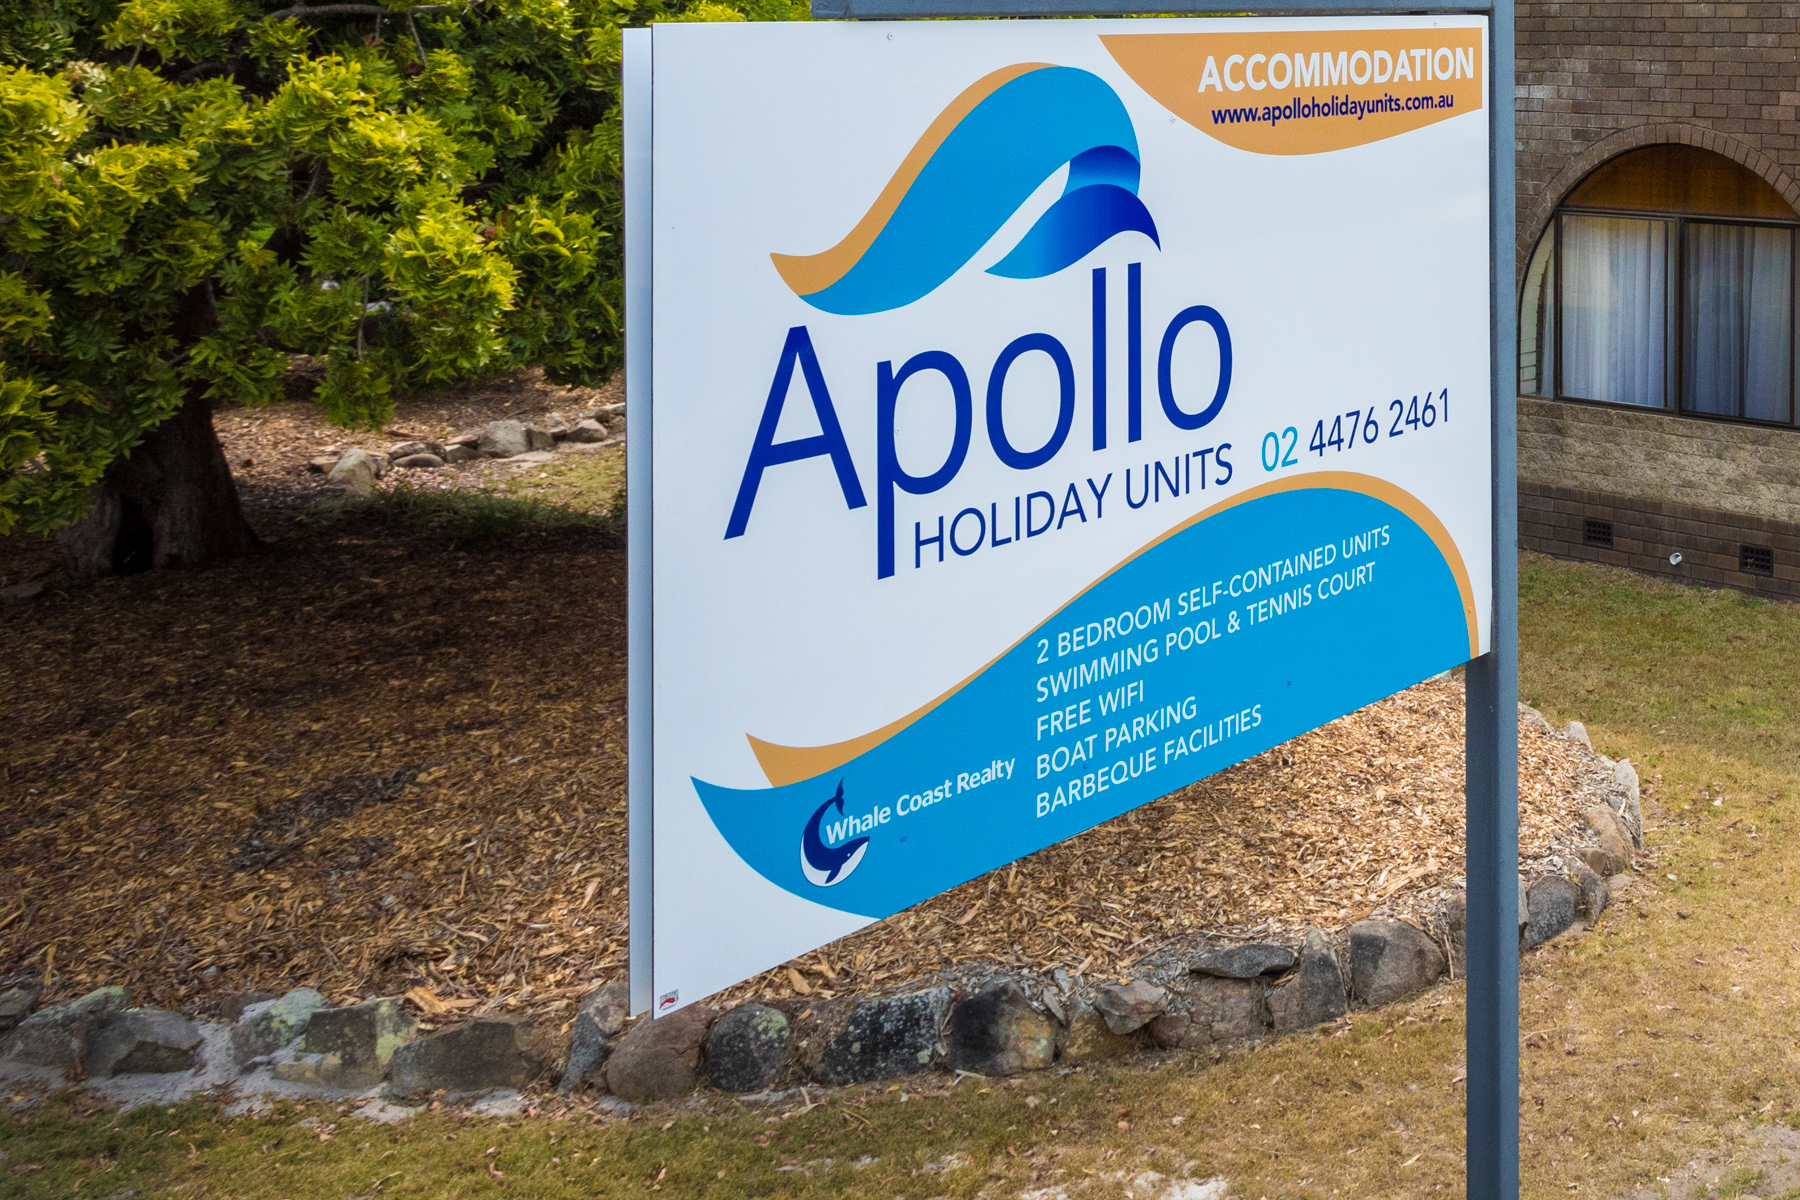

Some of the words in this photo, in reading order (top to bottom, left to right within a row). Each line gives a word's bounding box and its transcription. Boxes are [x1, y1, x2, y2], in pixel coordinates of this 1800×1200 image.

[1198, 47, 1473, 93] ACCOMMODATION
[1211, 93, 1454, 127] www.apolloholidayunits.com.au
[723, 262, 1233, 579] Apollo
[915, 473, 1112, 569] HOLIDAY
[1125, 443, 1233, 509] UNITS
[1261, 426, 1299, 471] 02
[1309, 406, 1379, 457] 4476
[1389, 388, 1449, 437] 2461
[1036, 639, 1049, 664] 2
[1058, 598, 1171, 657] BEDROOM
[1178, 543, 1336, 616] SELF-CONTAINED
[1342, 525, 1390, 559] UNITS
[1036, 638, 1158, 703] SWIMMING
[1166, 618, 1221, 655] POOL
[1227, 611, 1240, 633] &
[1247, 584, 1312, 625] TENNIS
[1317, 562, 1376, 600] COURT
[1037, 699, 1091, 741] FREE
[1098, 680, 1144, 711] WIFI
[1037, 735, 1097, 779] BOAT
[1105, 696, 1197, 760] PARKING
[826, 806, 891, 845] Whale
[896, 779, 952, 816] Coast
[957, 758, 1015, 794] Realty
[1036, 748, 1156, 818] BARBEQUE
[1164, 704, 1262, 764] FACILITIES
